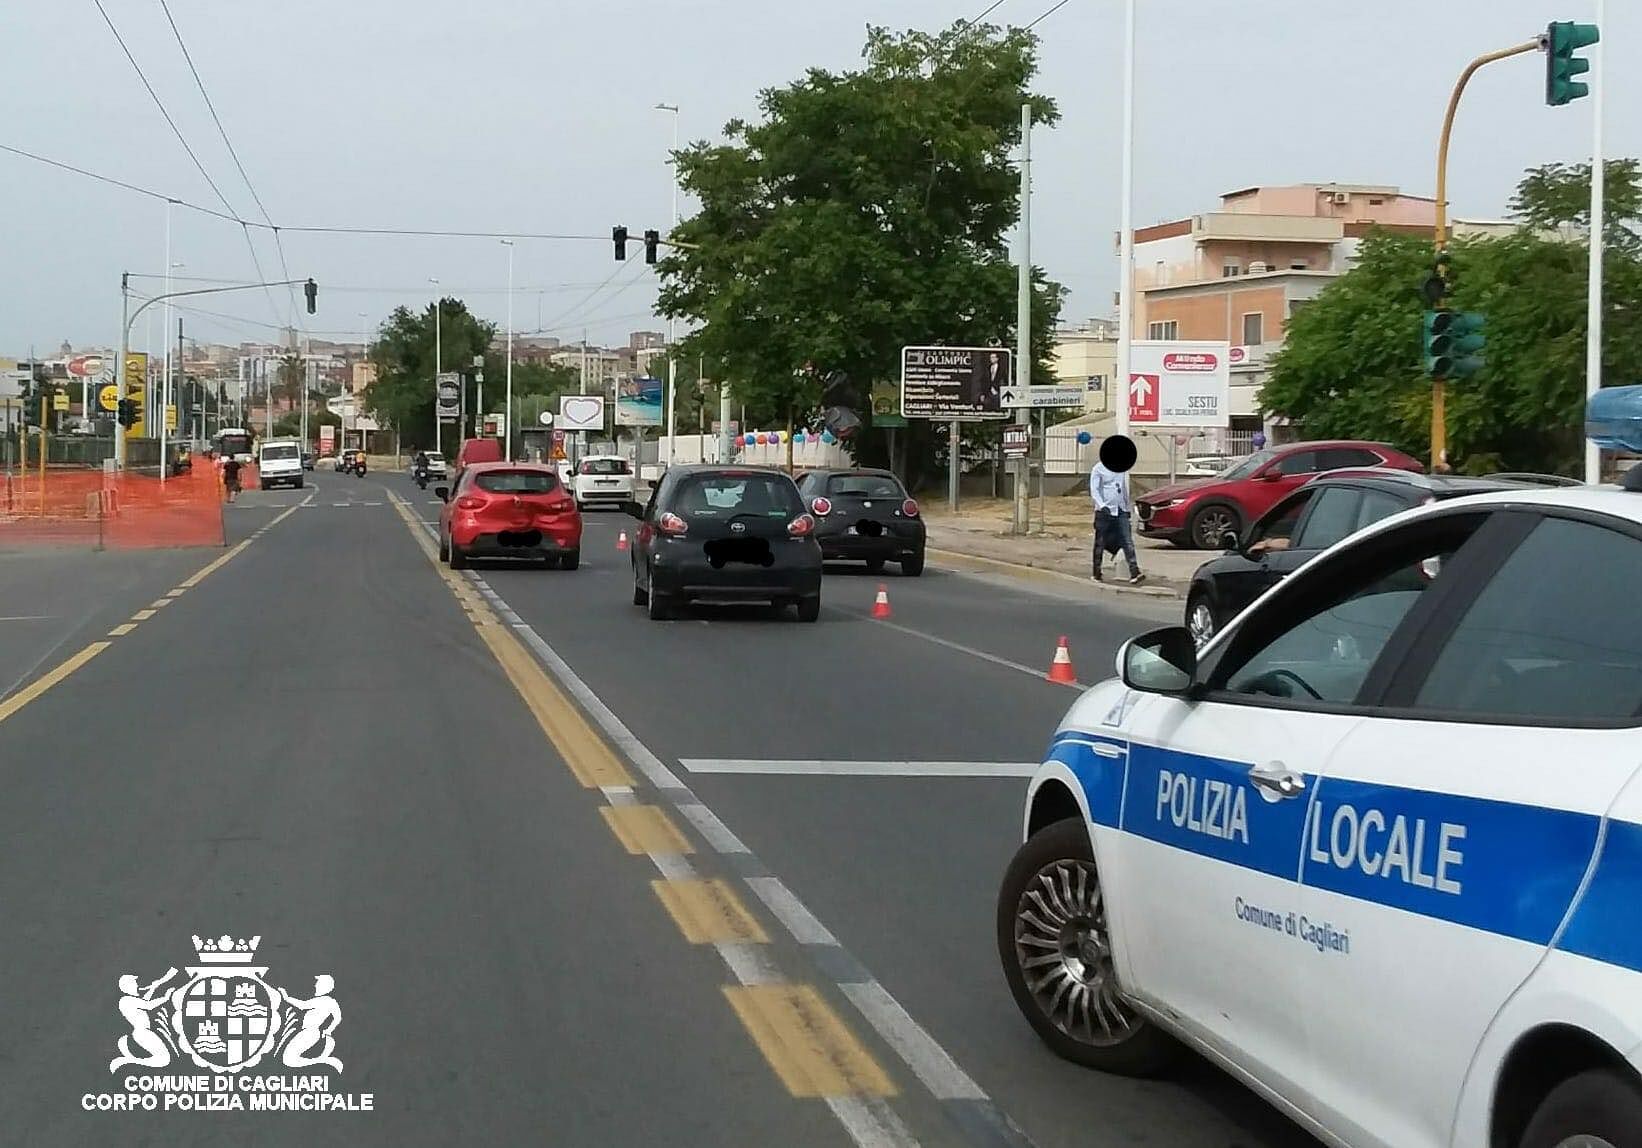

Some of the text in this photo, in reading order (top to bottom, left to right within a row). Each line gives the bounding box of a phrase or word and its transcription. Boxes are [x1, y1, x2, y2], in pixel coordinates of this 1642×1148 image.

[926, 355, 971, 365] OLIMPIC
[1033, 397, 1081, 405] carabinieri
[1188, 396, 1218, 408] SESTU
[1156, 769, 1467, 895] POLIZIA LOCALE
[1234, 896, 1350, 954] Comune di Cagliari
